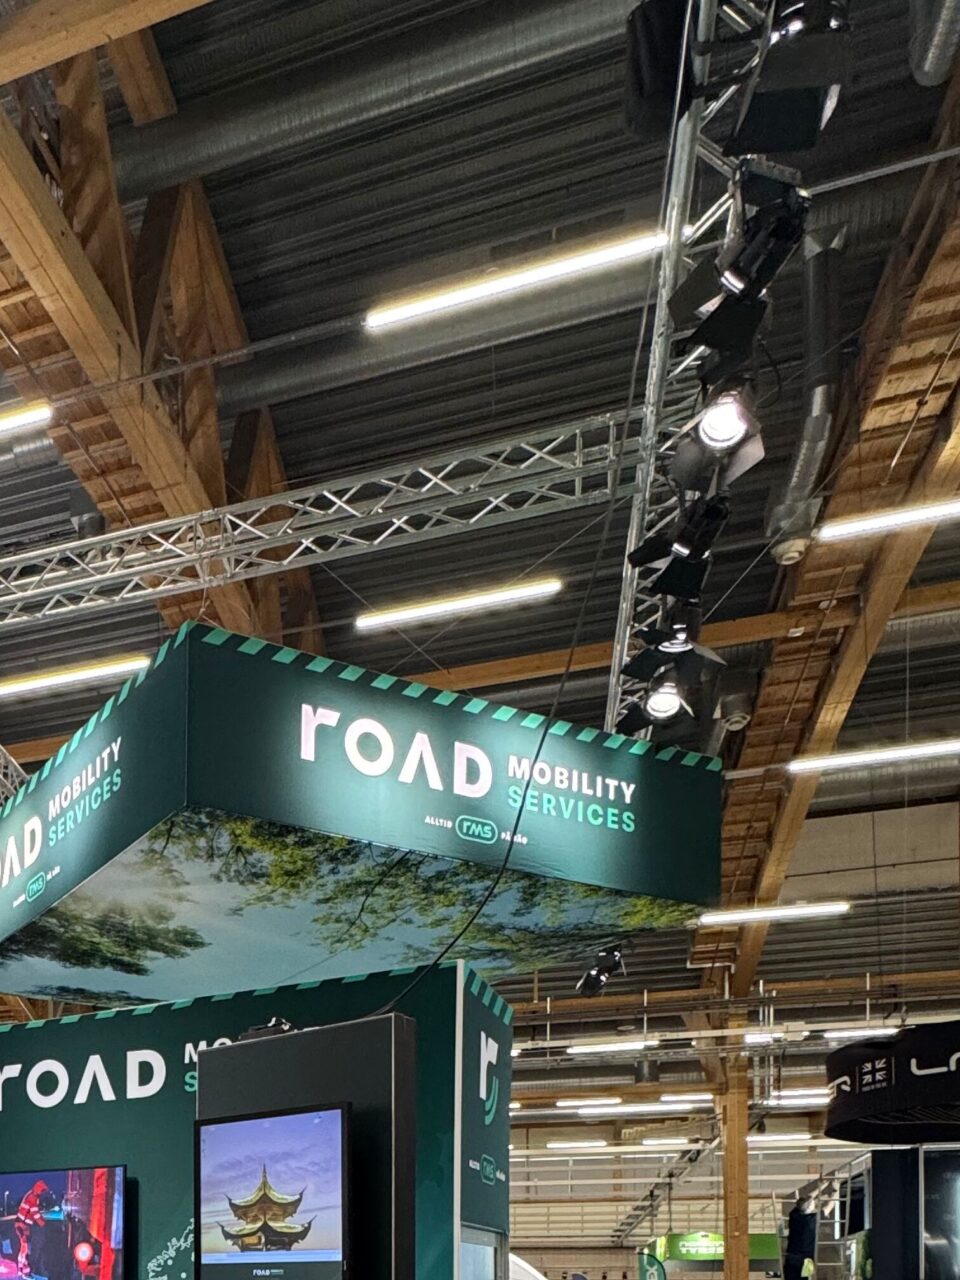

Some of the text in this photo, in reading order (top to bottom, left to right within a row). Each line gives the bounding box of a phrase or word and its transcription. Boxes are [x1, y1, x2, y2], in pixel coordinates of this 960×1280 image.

[48, 736, 122, 821] MOBILITY
[507, 755, 636, 804] MOBILITY
[49, 768, 122, 847] SERVICES
[424, 815, 453, 829] ALLTID
[508, 785, 636, 833] SERVICES
